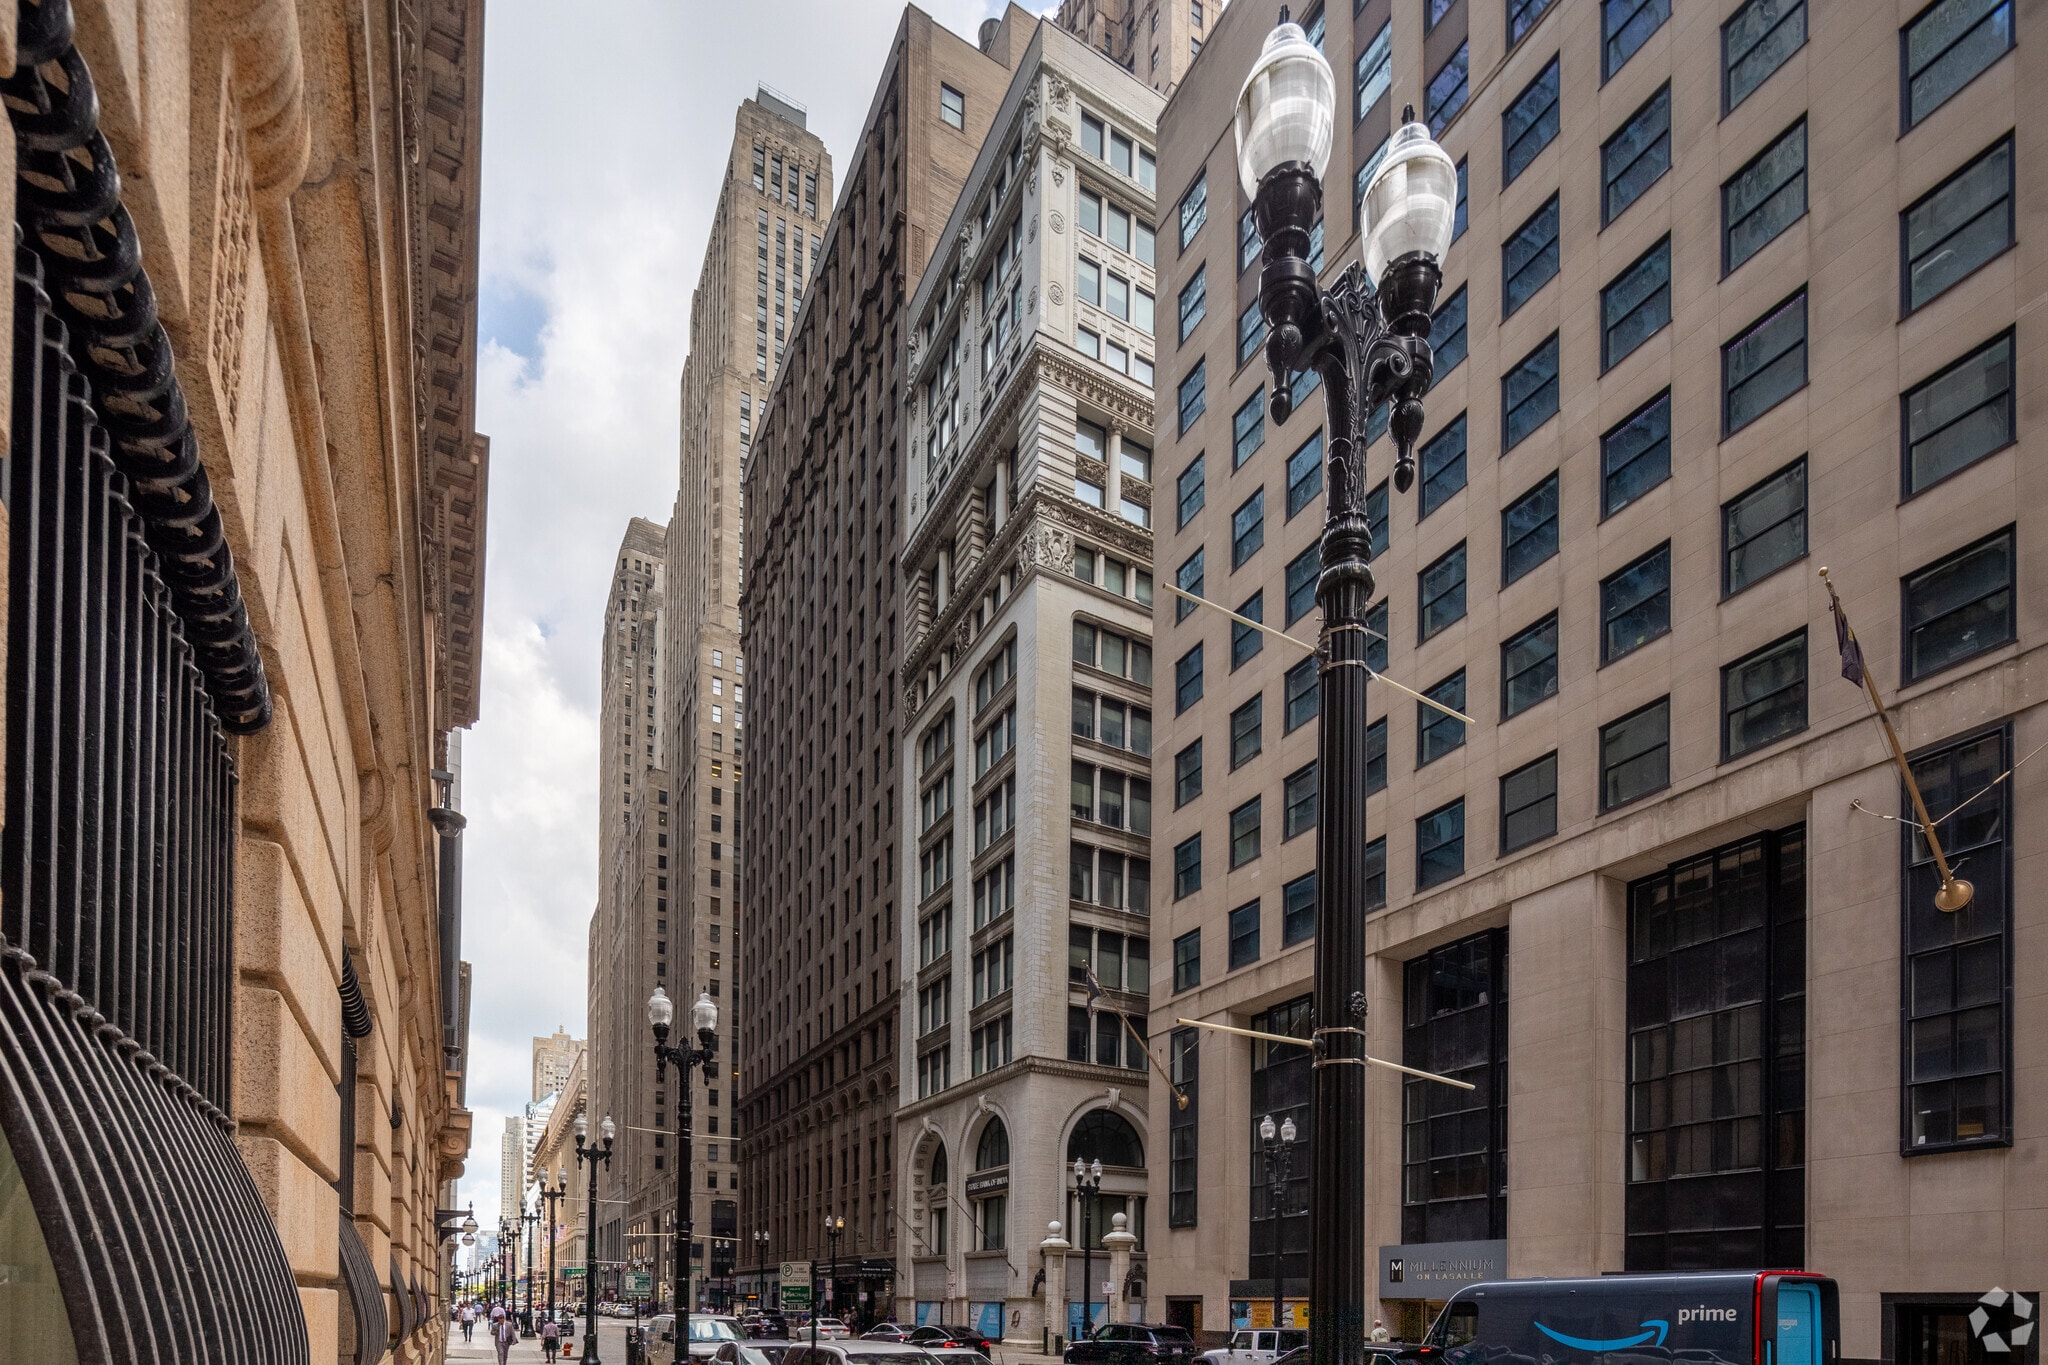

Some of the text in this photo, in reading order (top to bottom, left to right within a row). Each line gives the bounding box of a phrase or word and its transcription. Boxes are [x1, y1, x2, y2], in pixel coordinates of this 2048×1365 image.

[1410, 1260, 1493, 1271] MILLENNIUM
[1435, 1272, 1483, 1280] LASALLE
[1678, 1304, 1737, 1325] prime
